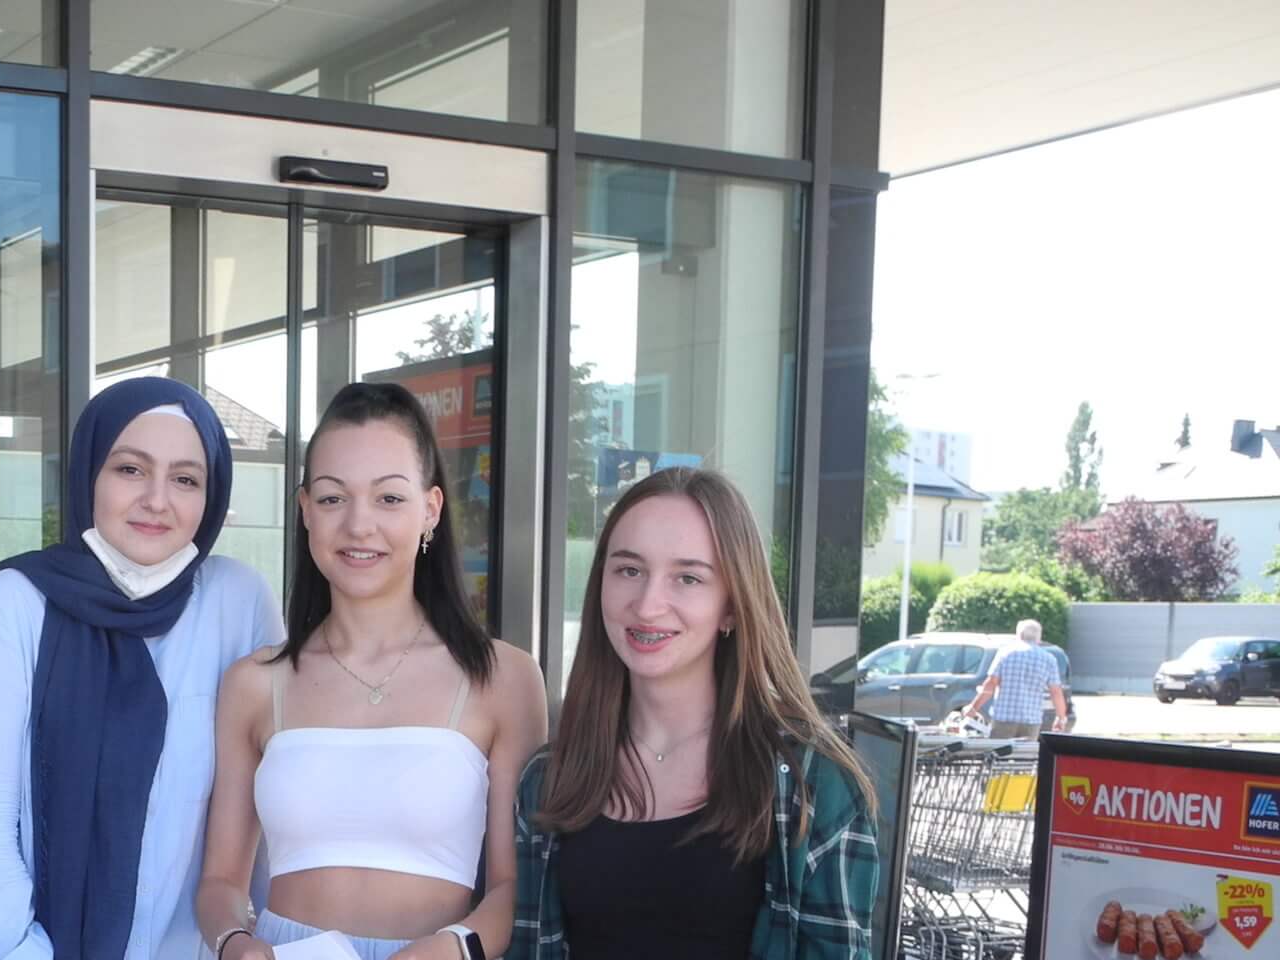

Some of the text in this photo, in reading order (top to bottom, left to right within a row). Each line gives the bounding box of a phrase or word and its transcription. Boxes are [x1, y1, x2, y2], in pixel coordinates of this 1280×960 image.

[1093, 783, 1223, 830] AKTIONEN
[1248, 818, 1280, 832] HOFER
[1223, 882, 1265, 900] -22%
[1233, 915, 1258, 931] 1,59
